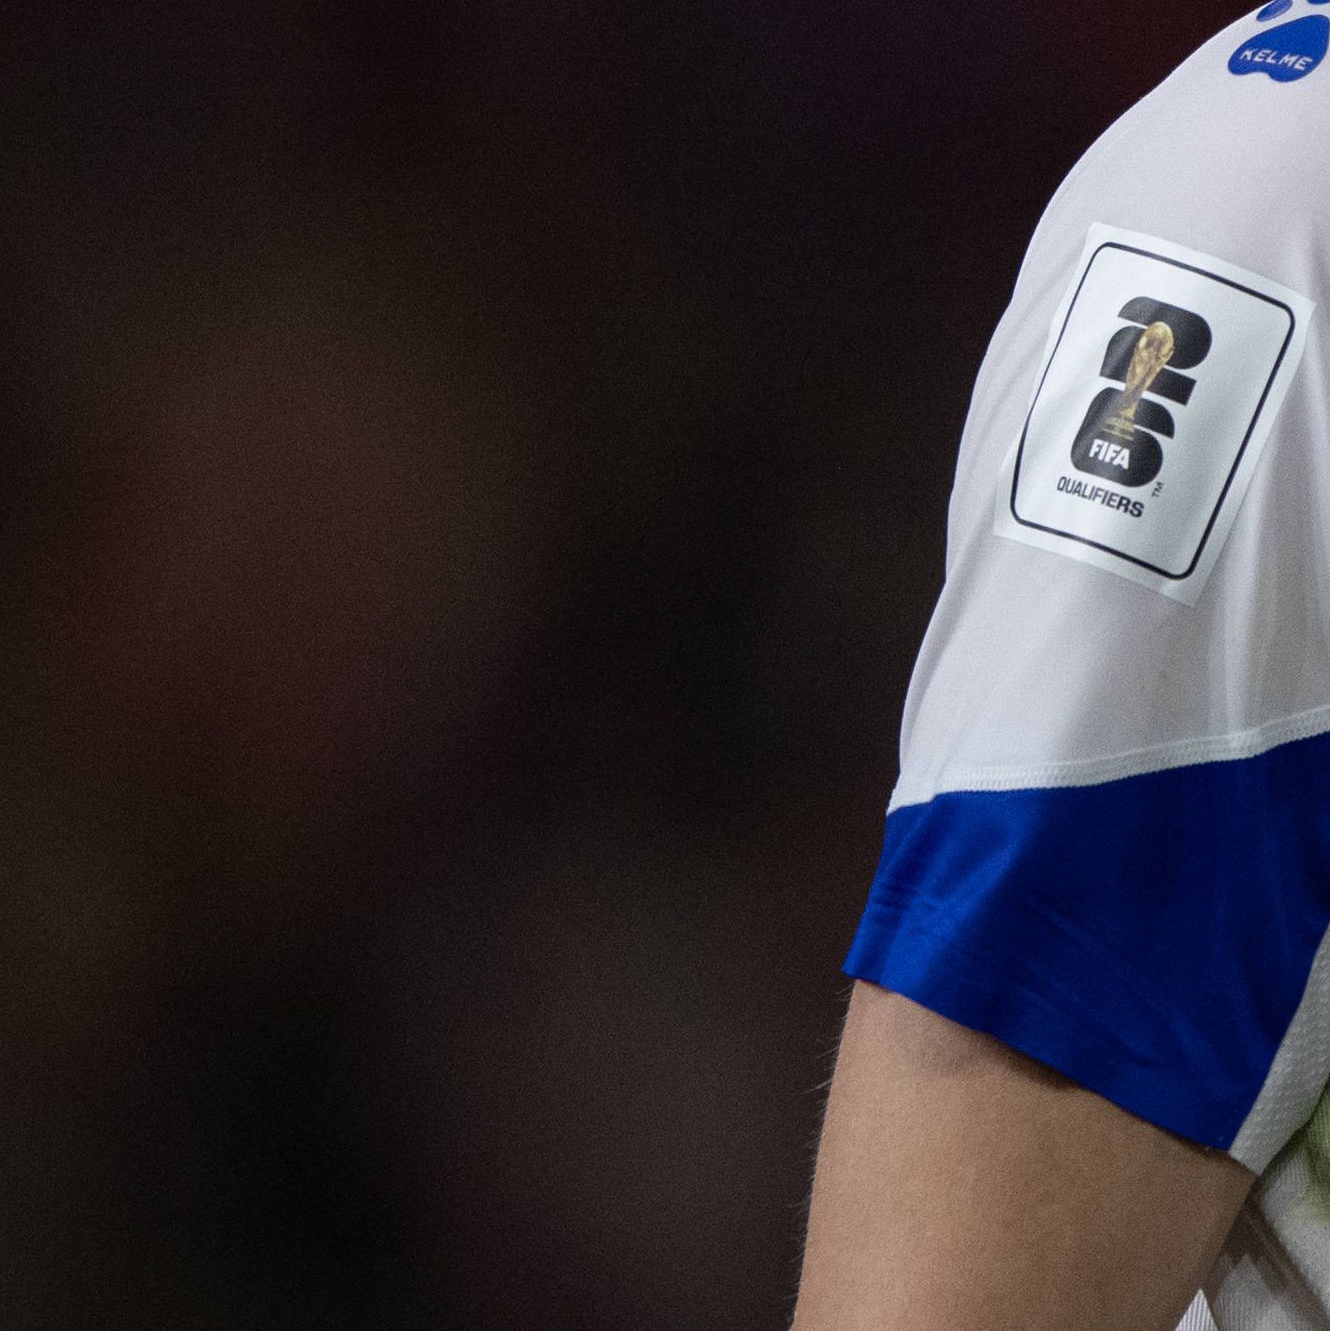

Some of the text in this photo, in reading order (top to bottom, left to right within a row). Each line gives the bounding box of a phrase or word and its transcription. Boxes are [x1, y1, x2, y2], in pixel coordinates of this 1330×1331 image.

[1239, 47, 1314, 71] KELME
[1088, 437, 1131, 470] FIFA
[1056, 475, 1145, 519] QUALIFIERS
